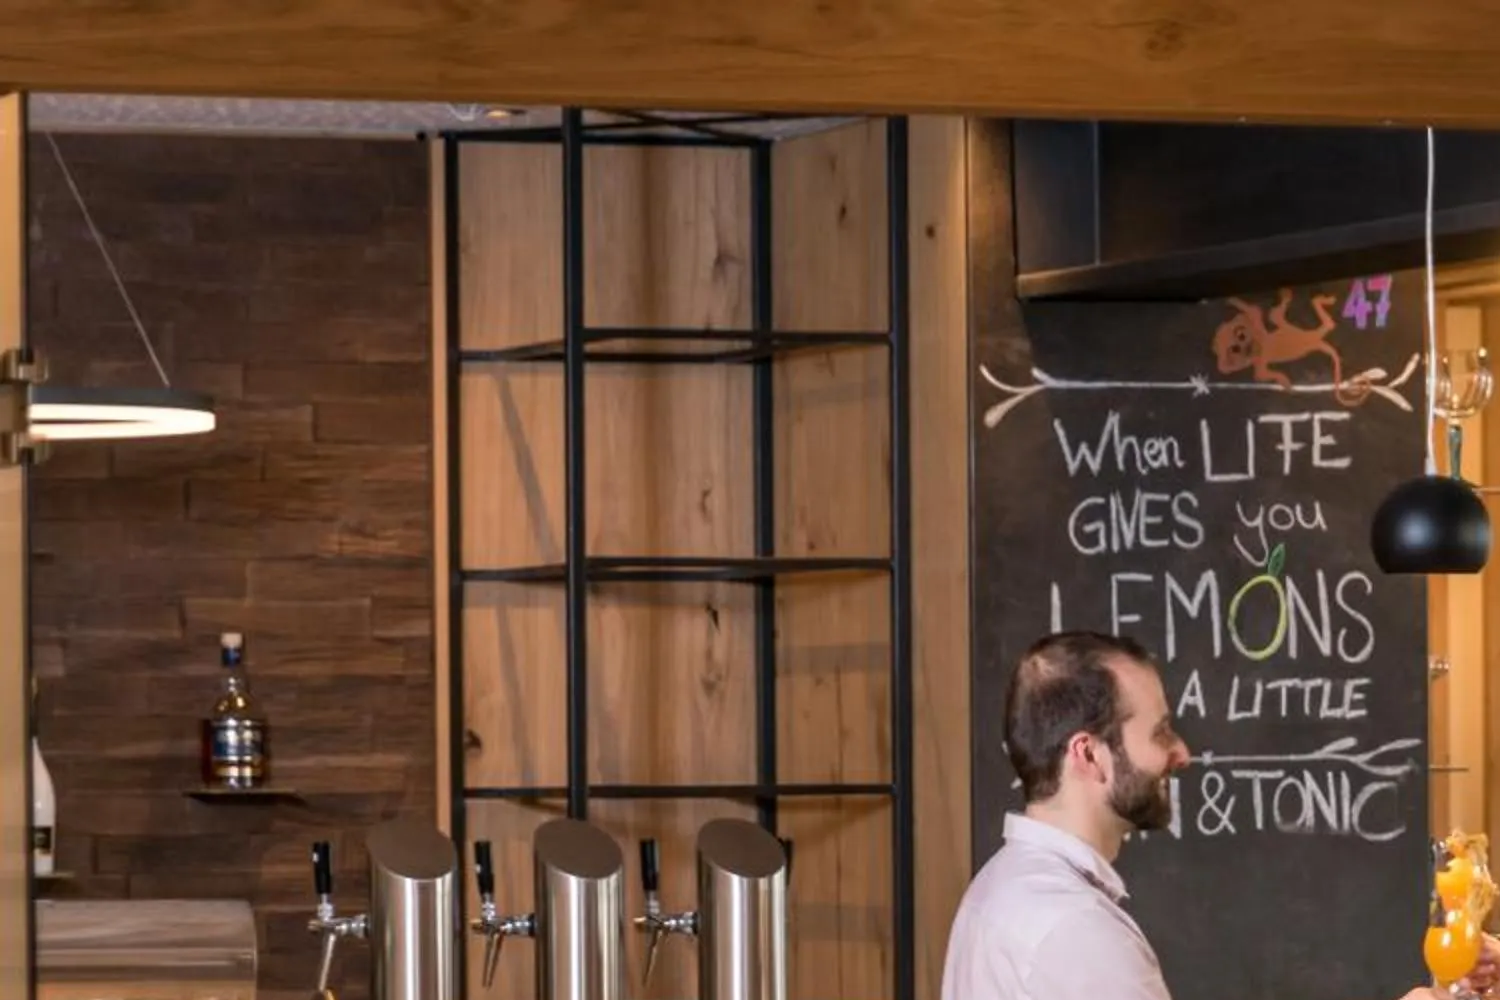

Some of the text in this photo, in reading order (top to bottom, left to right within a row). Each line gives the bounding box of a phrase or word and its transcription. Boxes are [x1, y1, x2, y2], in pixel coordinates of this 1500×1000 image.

[1342, 273, 1392, 329] 47
[1053, 410, 1352, 483] When LIFE
[1068, 491, 1327, 567] GIVES you
[1176, 669, 1371, 722] A LITTLE
